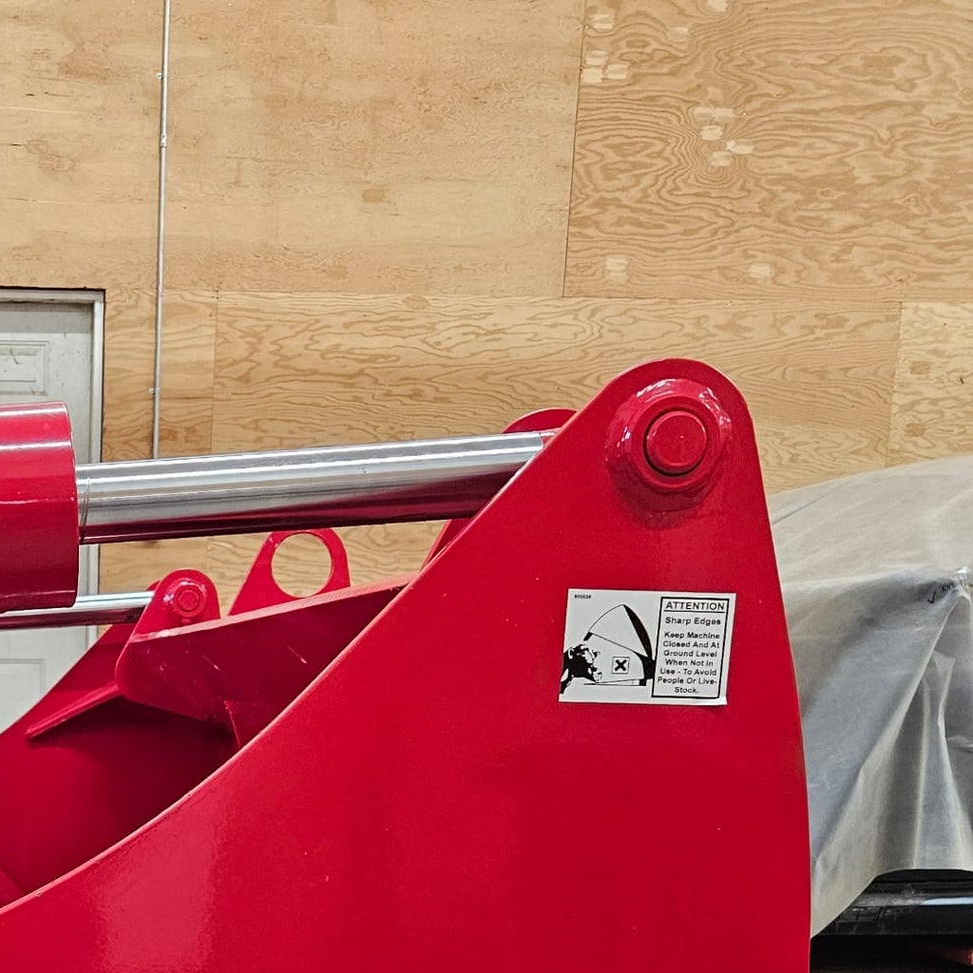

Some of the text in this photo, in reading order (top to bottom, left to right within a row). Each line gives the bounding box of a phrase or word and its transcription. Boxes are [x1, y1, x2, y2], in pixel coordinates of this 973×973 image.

[665, 601, 725, 611] ATTENTION
[665, 617, 721, 626] Sharp Edges
[664, 631, 685, 639] Keep
[662, 640, 690, 648] Closed
[711, 641, 720, 649] At
[663, 649, 718, 658] Ground Level
[690, 659, 704, 667] Not
[683, 668, 693, 676] To
[657, 676, 684, 685] People
[698, 677, 718, 685] Live-
